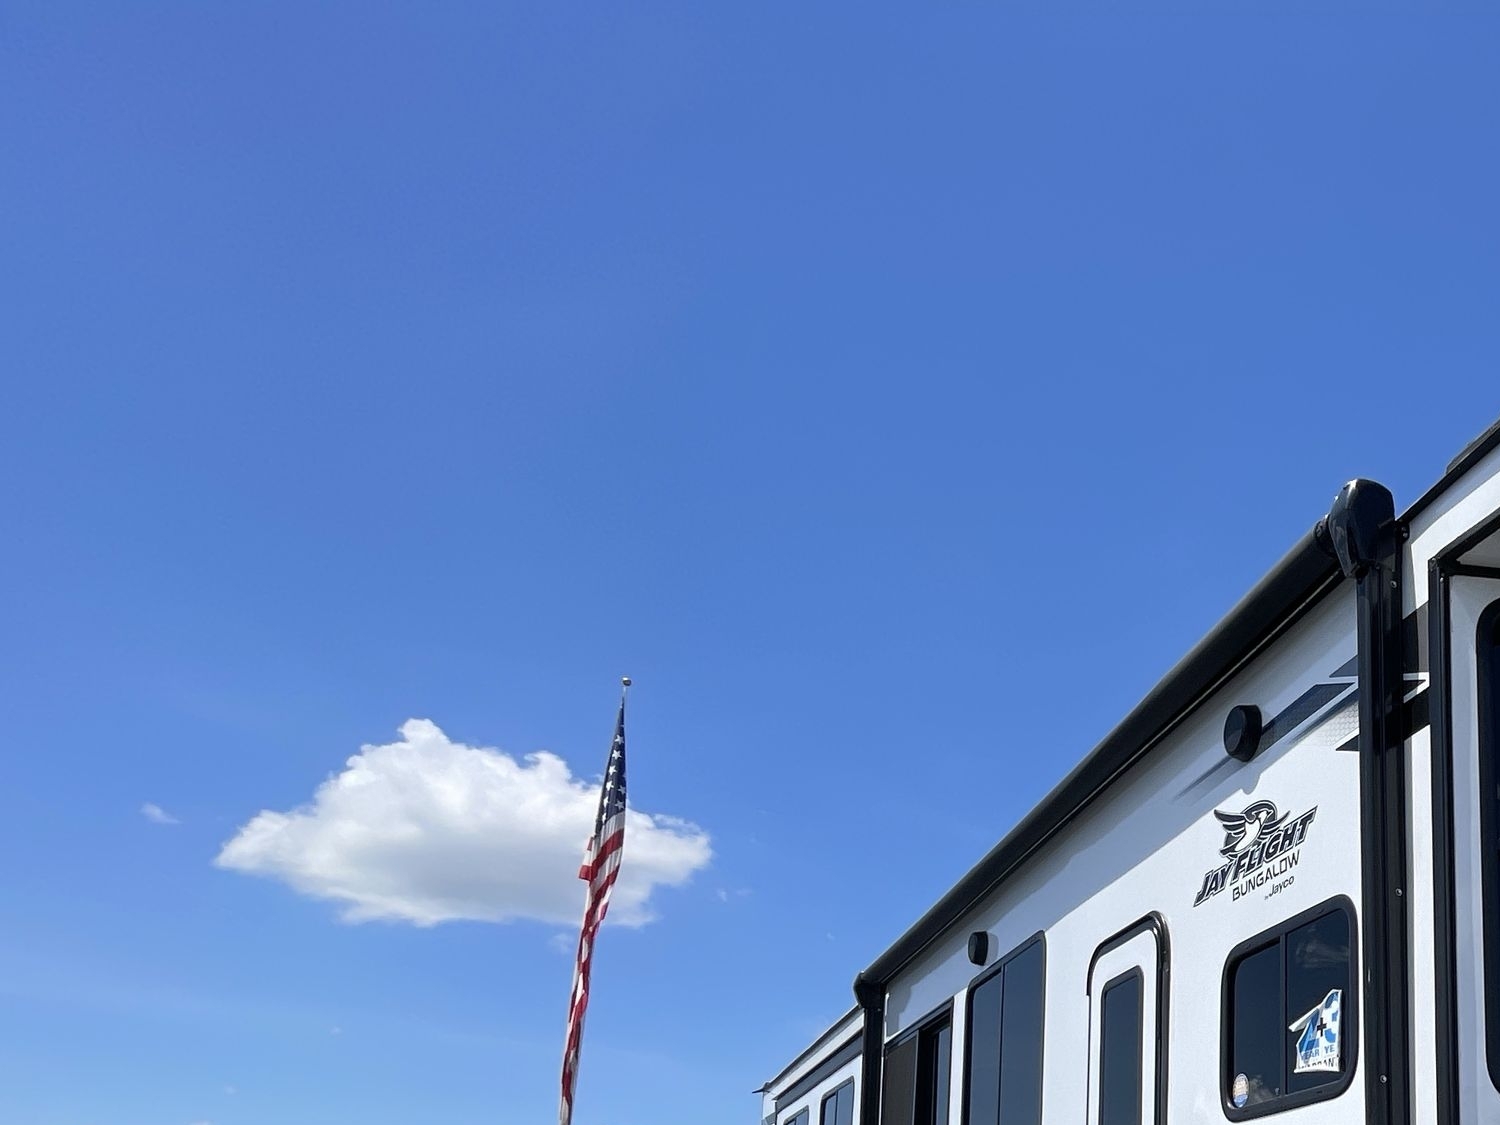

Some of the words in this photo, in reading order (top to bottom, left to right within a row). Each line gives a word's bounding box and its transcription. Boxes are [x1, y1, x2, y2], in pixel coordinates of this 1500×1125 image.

[1230, 805, 1318, 886] FLIGHT
[1232, 849, 1300, 902] BUNGALOW
[1269, 876, 1295, 898] Jayco
